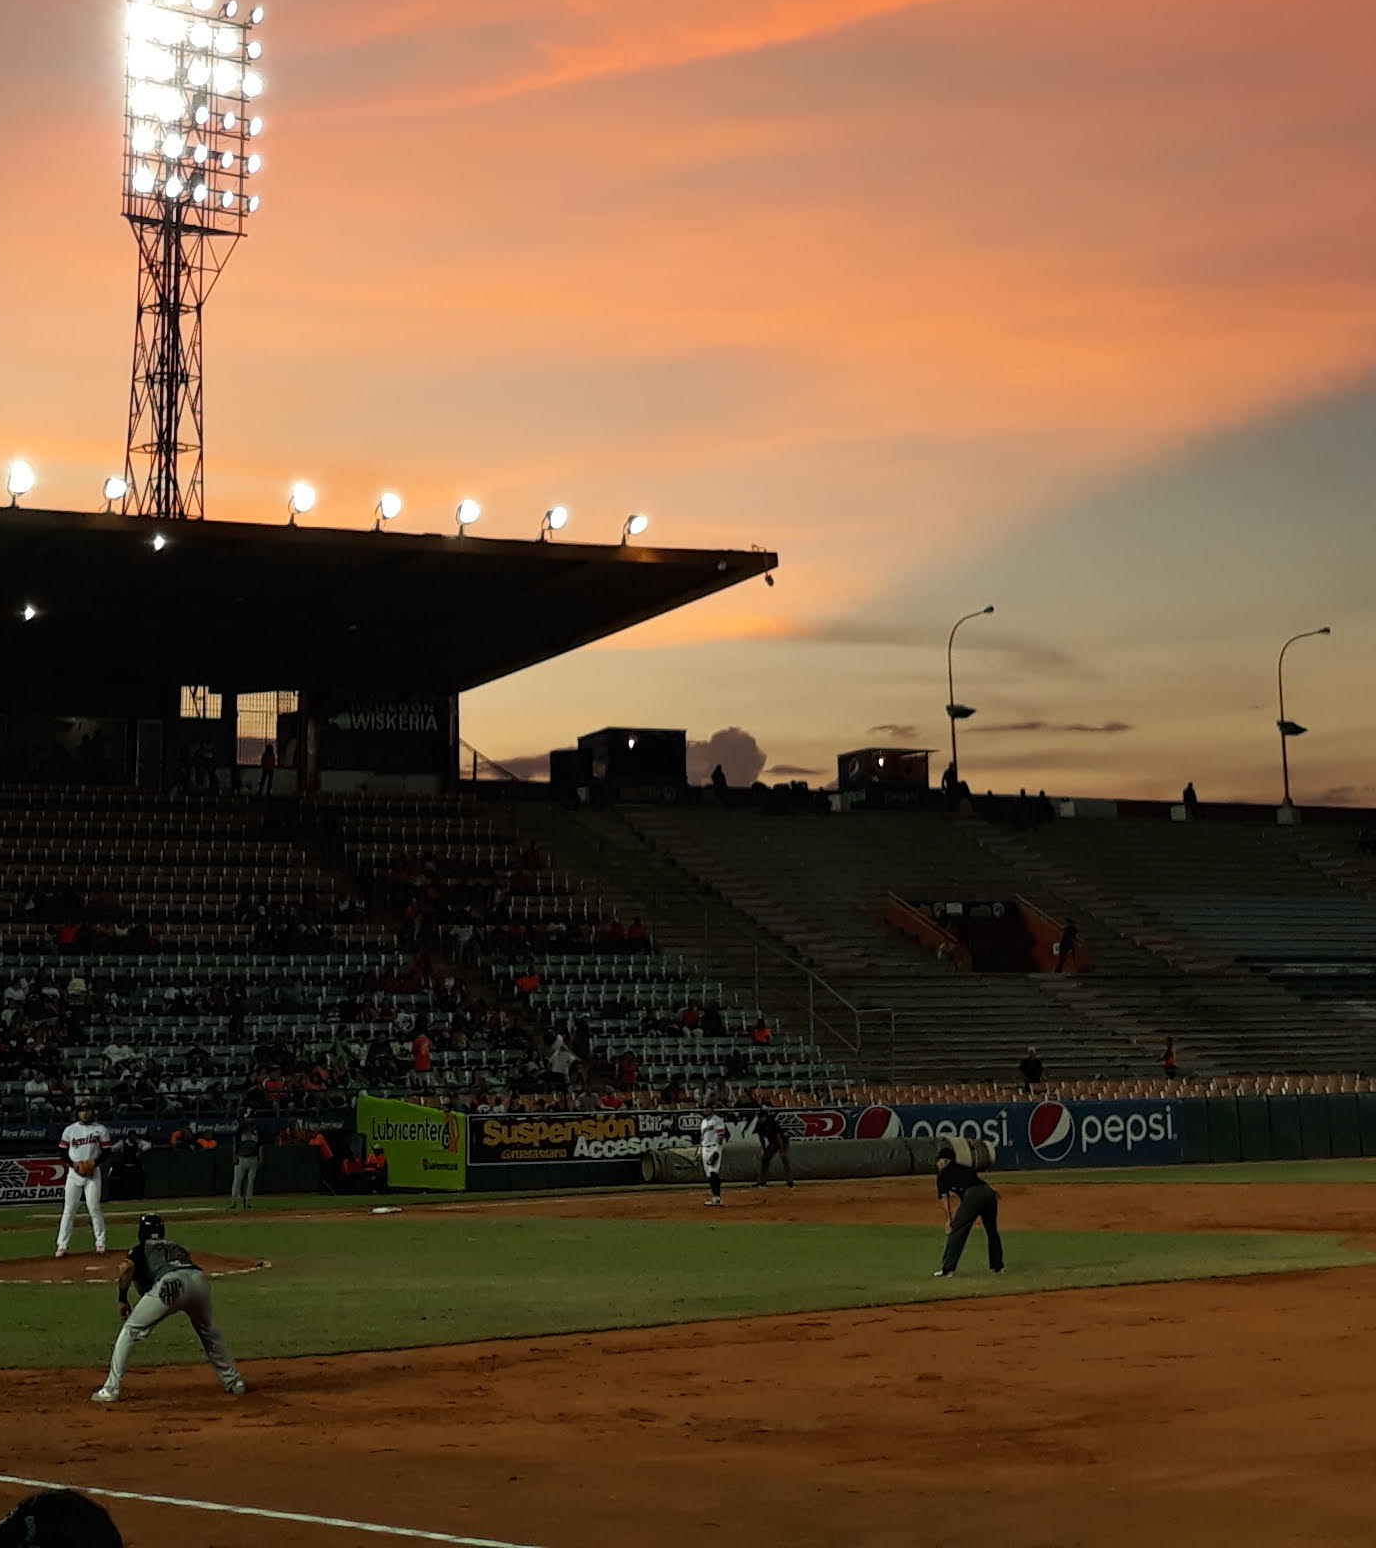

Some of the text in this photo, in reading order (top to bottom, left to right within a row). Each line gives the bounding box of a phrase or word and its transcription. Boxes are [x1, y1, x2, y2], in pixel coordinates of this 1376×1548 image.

[352, 712, 438, 732] WISKERIA
[483, 1114, 636, 1147] Suspensión
[1081, 1105, 1174, 1153] pepsi
[573, 1133, 693, 1159] Accesorios
